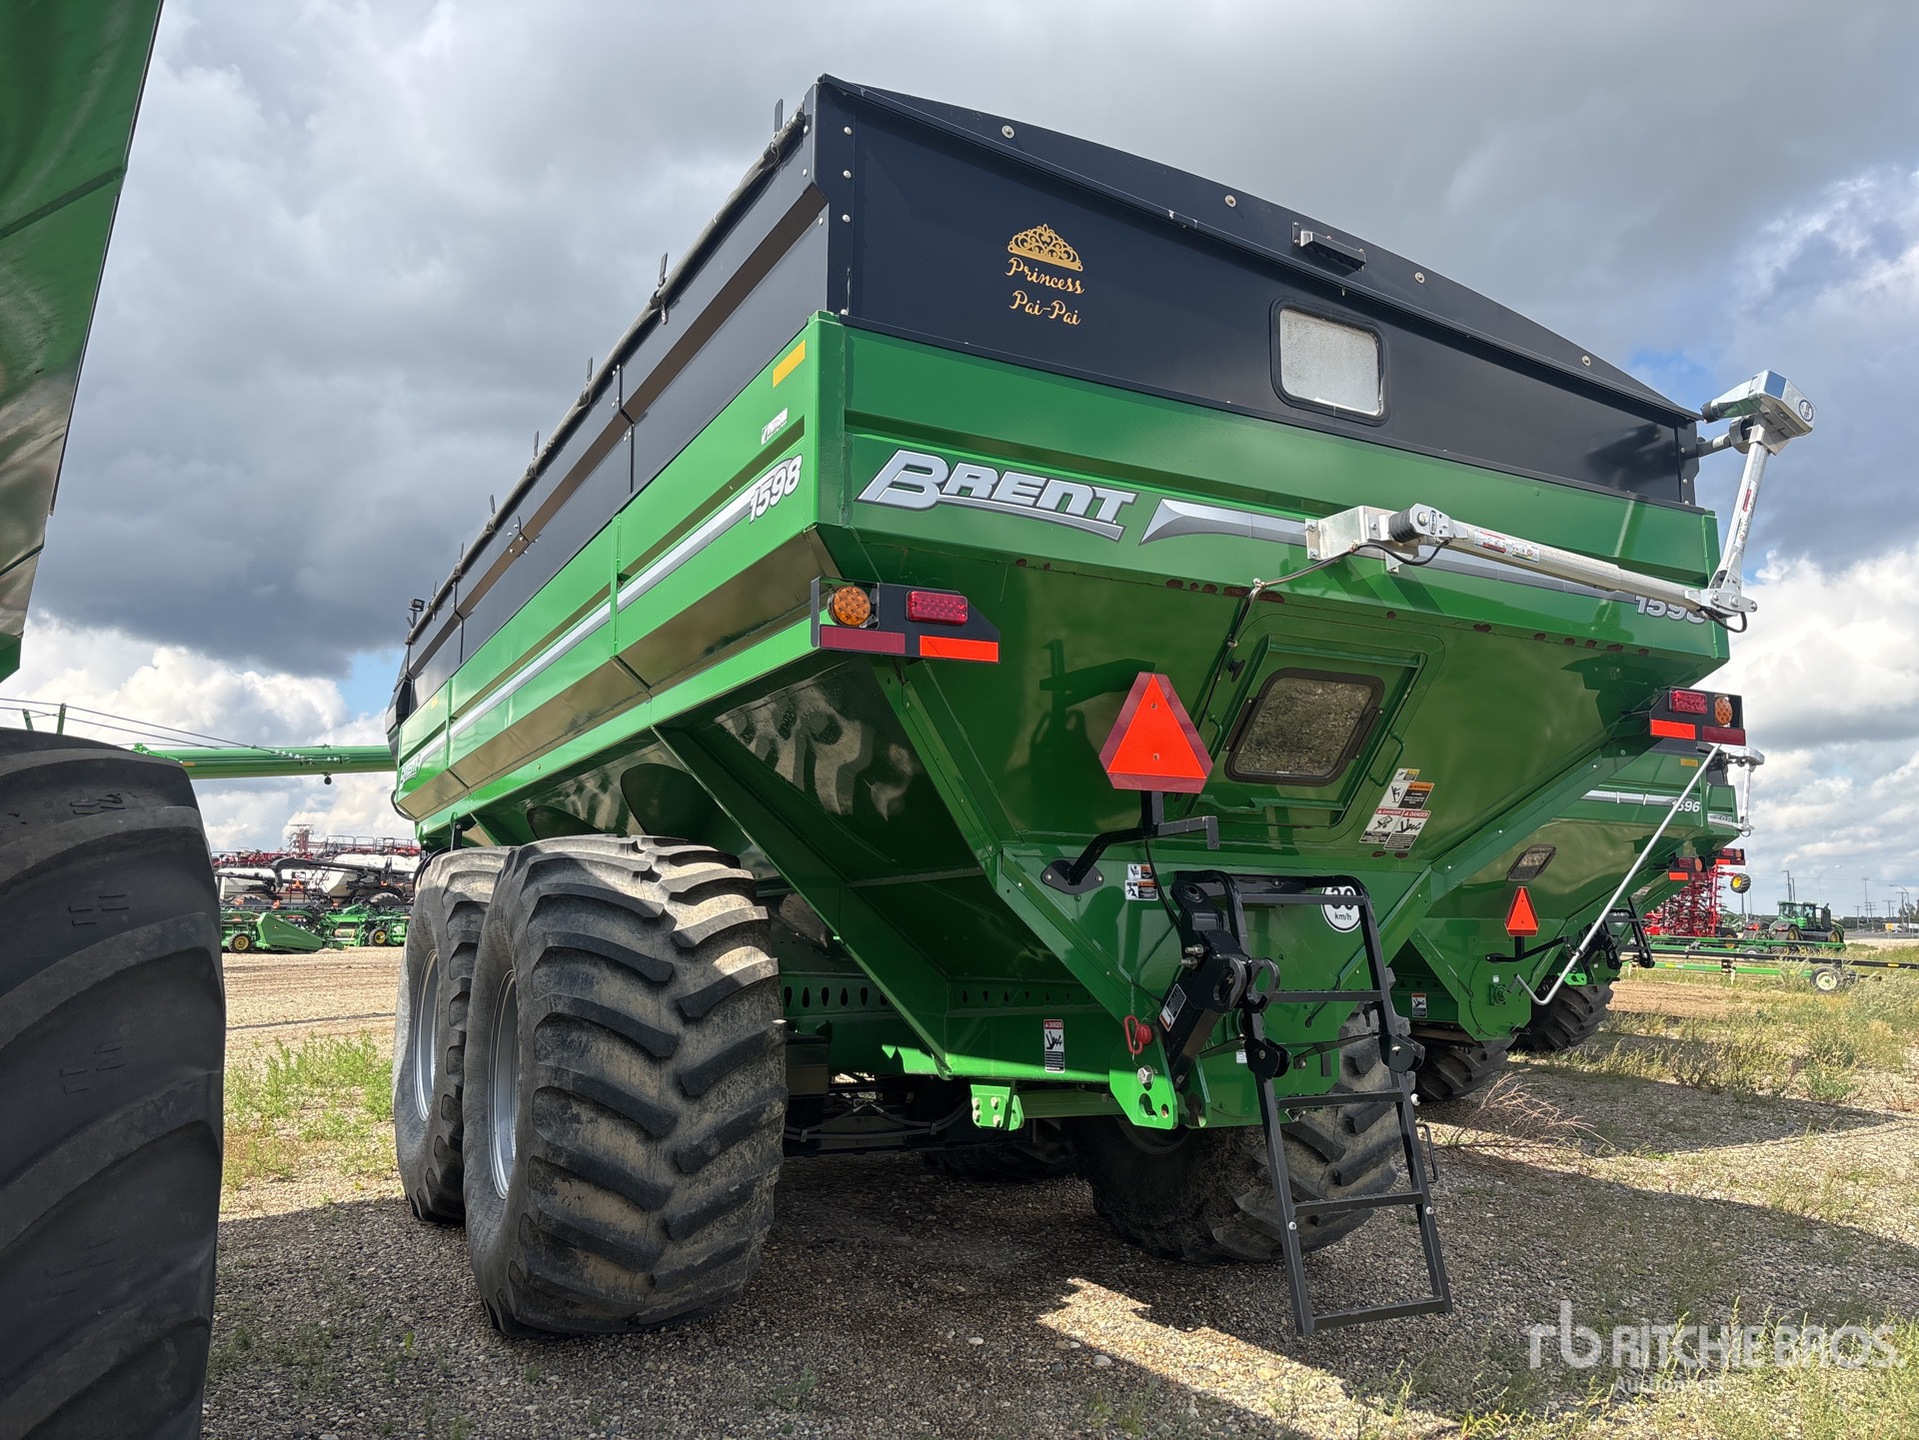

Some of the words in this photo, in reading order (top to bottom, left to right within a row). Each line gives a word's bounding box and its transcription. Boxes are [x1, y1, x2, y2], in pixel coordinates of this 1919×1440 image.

[1005, 257, 1085, 294] Princess
[1009, 290, 1081, 325] Pai-Pai
[749, 454, 803, 524] 1598
[1334, 912, 1352, 921] km/h
